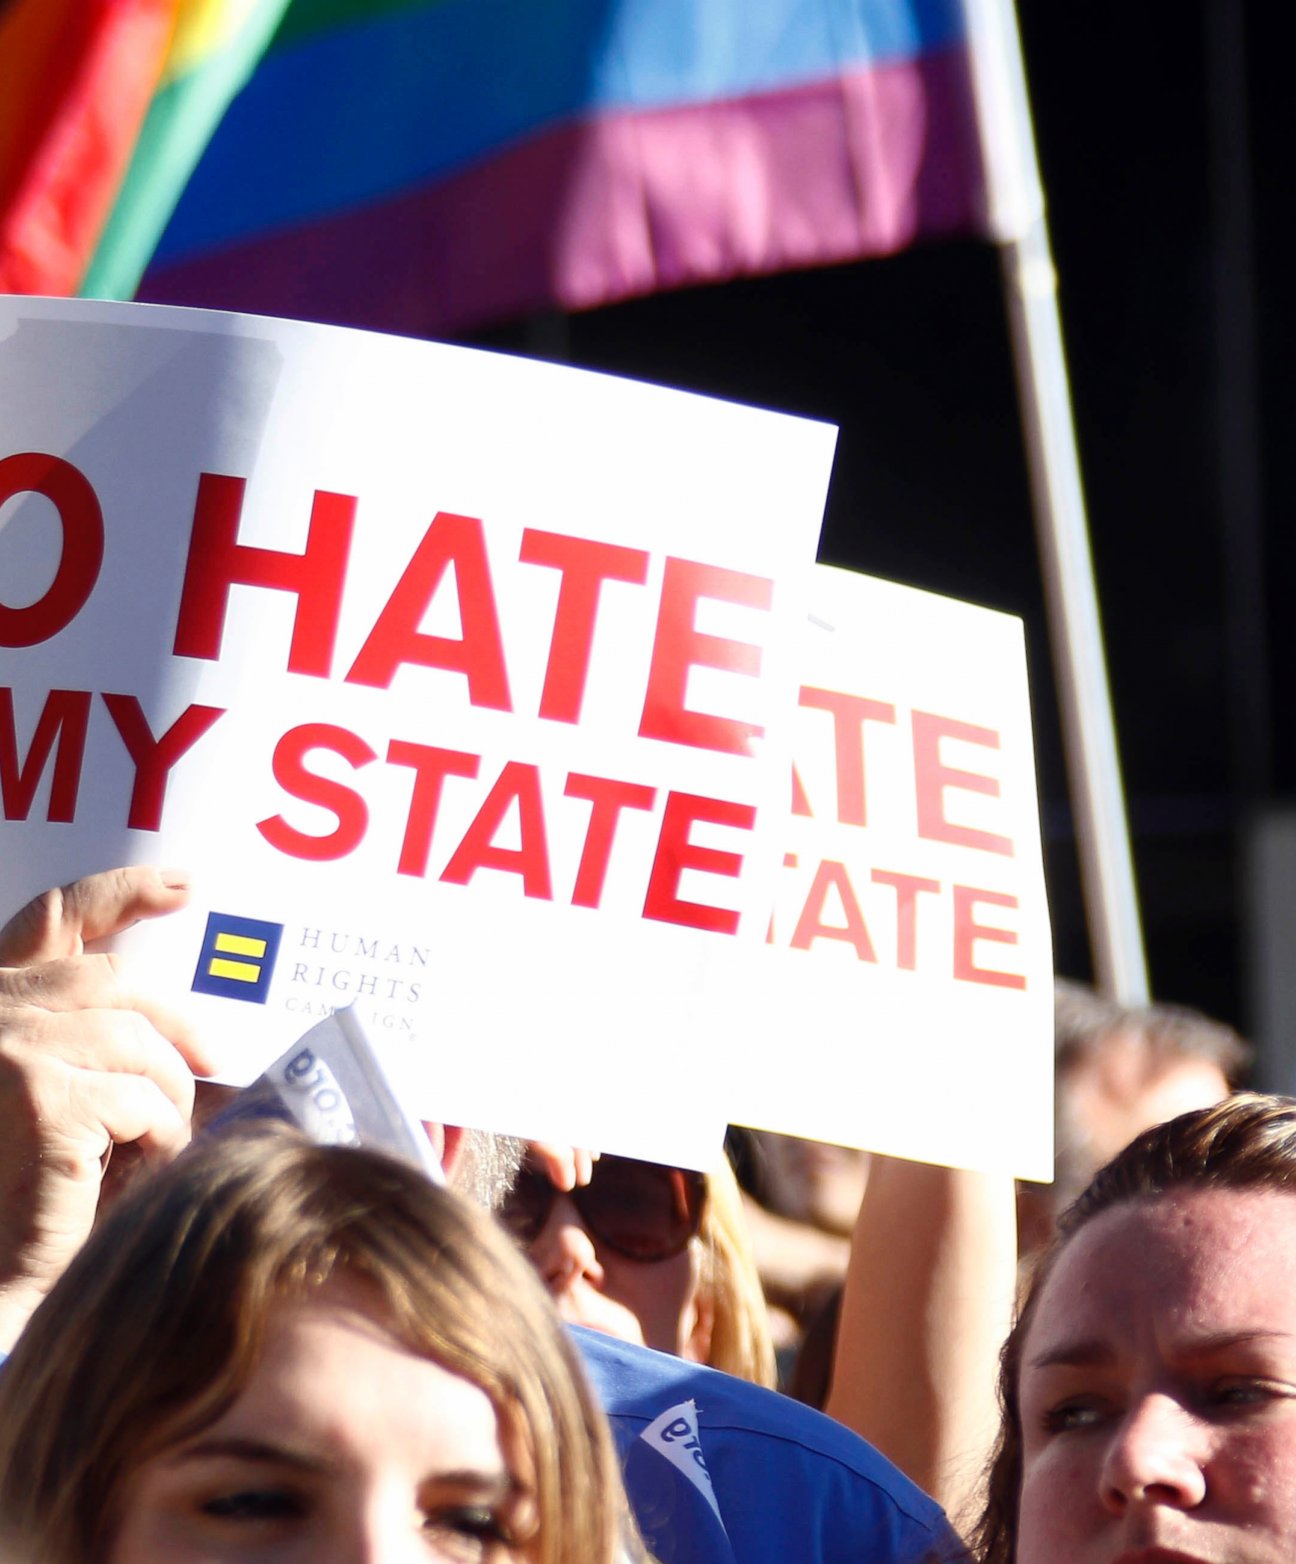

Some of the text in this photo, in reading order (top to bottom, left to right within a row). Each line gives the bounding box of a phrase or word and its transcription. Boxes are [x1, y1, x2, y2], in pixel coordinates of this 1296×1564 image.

[172, 472, 774, 758] HATE
[790, 684, 1015, 858] TE
[255, 722, 758, 937] STATE
[290, 961, 422, 1004] RIGHTS
[298, 926, 431, 967] HUMAN
[284, 997, 415, 1031] CAMIGN
